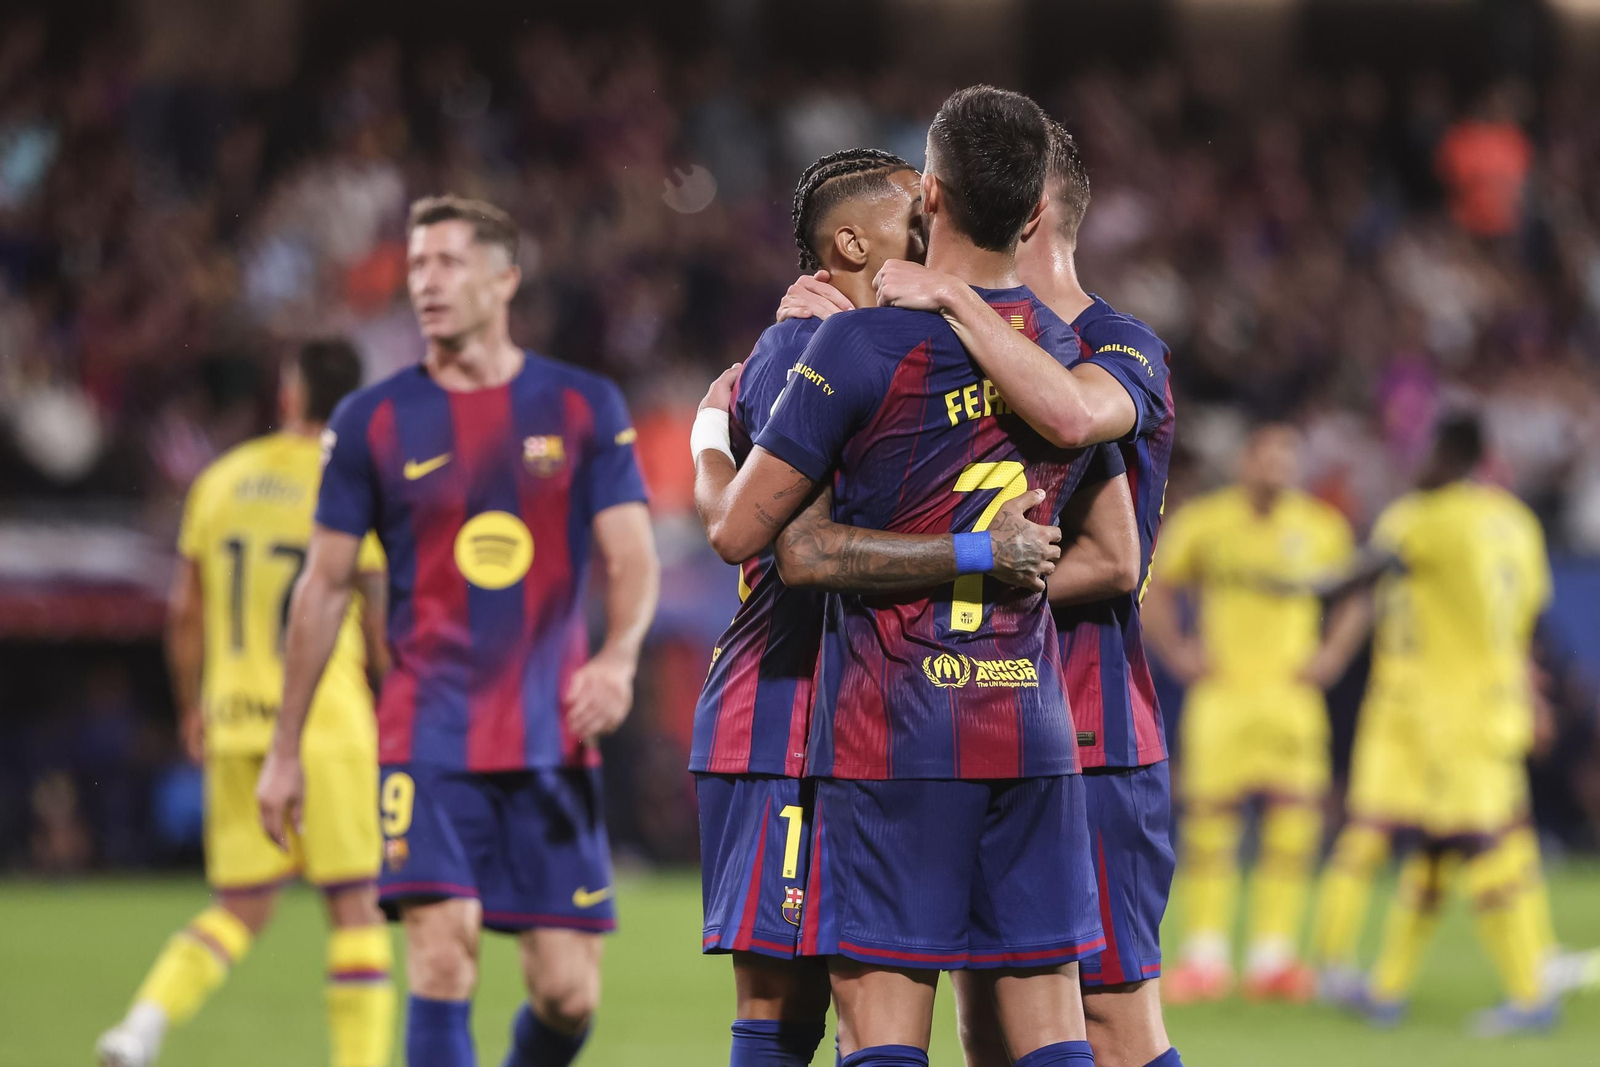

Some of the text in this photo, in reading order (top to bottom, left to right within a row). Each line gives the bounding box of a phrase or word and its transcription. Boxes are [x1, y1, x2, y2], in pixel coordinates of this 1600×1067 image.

[822, 383, 834, 396] tv
[951, 460, 1028, 632] 7
[975, 667, 1038, 681] ACNUR
[999, 681, 1020, 689] Refugee
[1020, 681, 1039, 689] Agency
[382, 771, 416, 838] 9
[779, 804, 804, 879] 1
